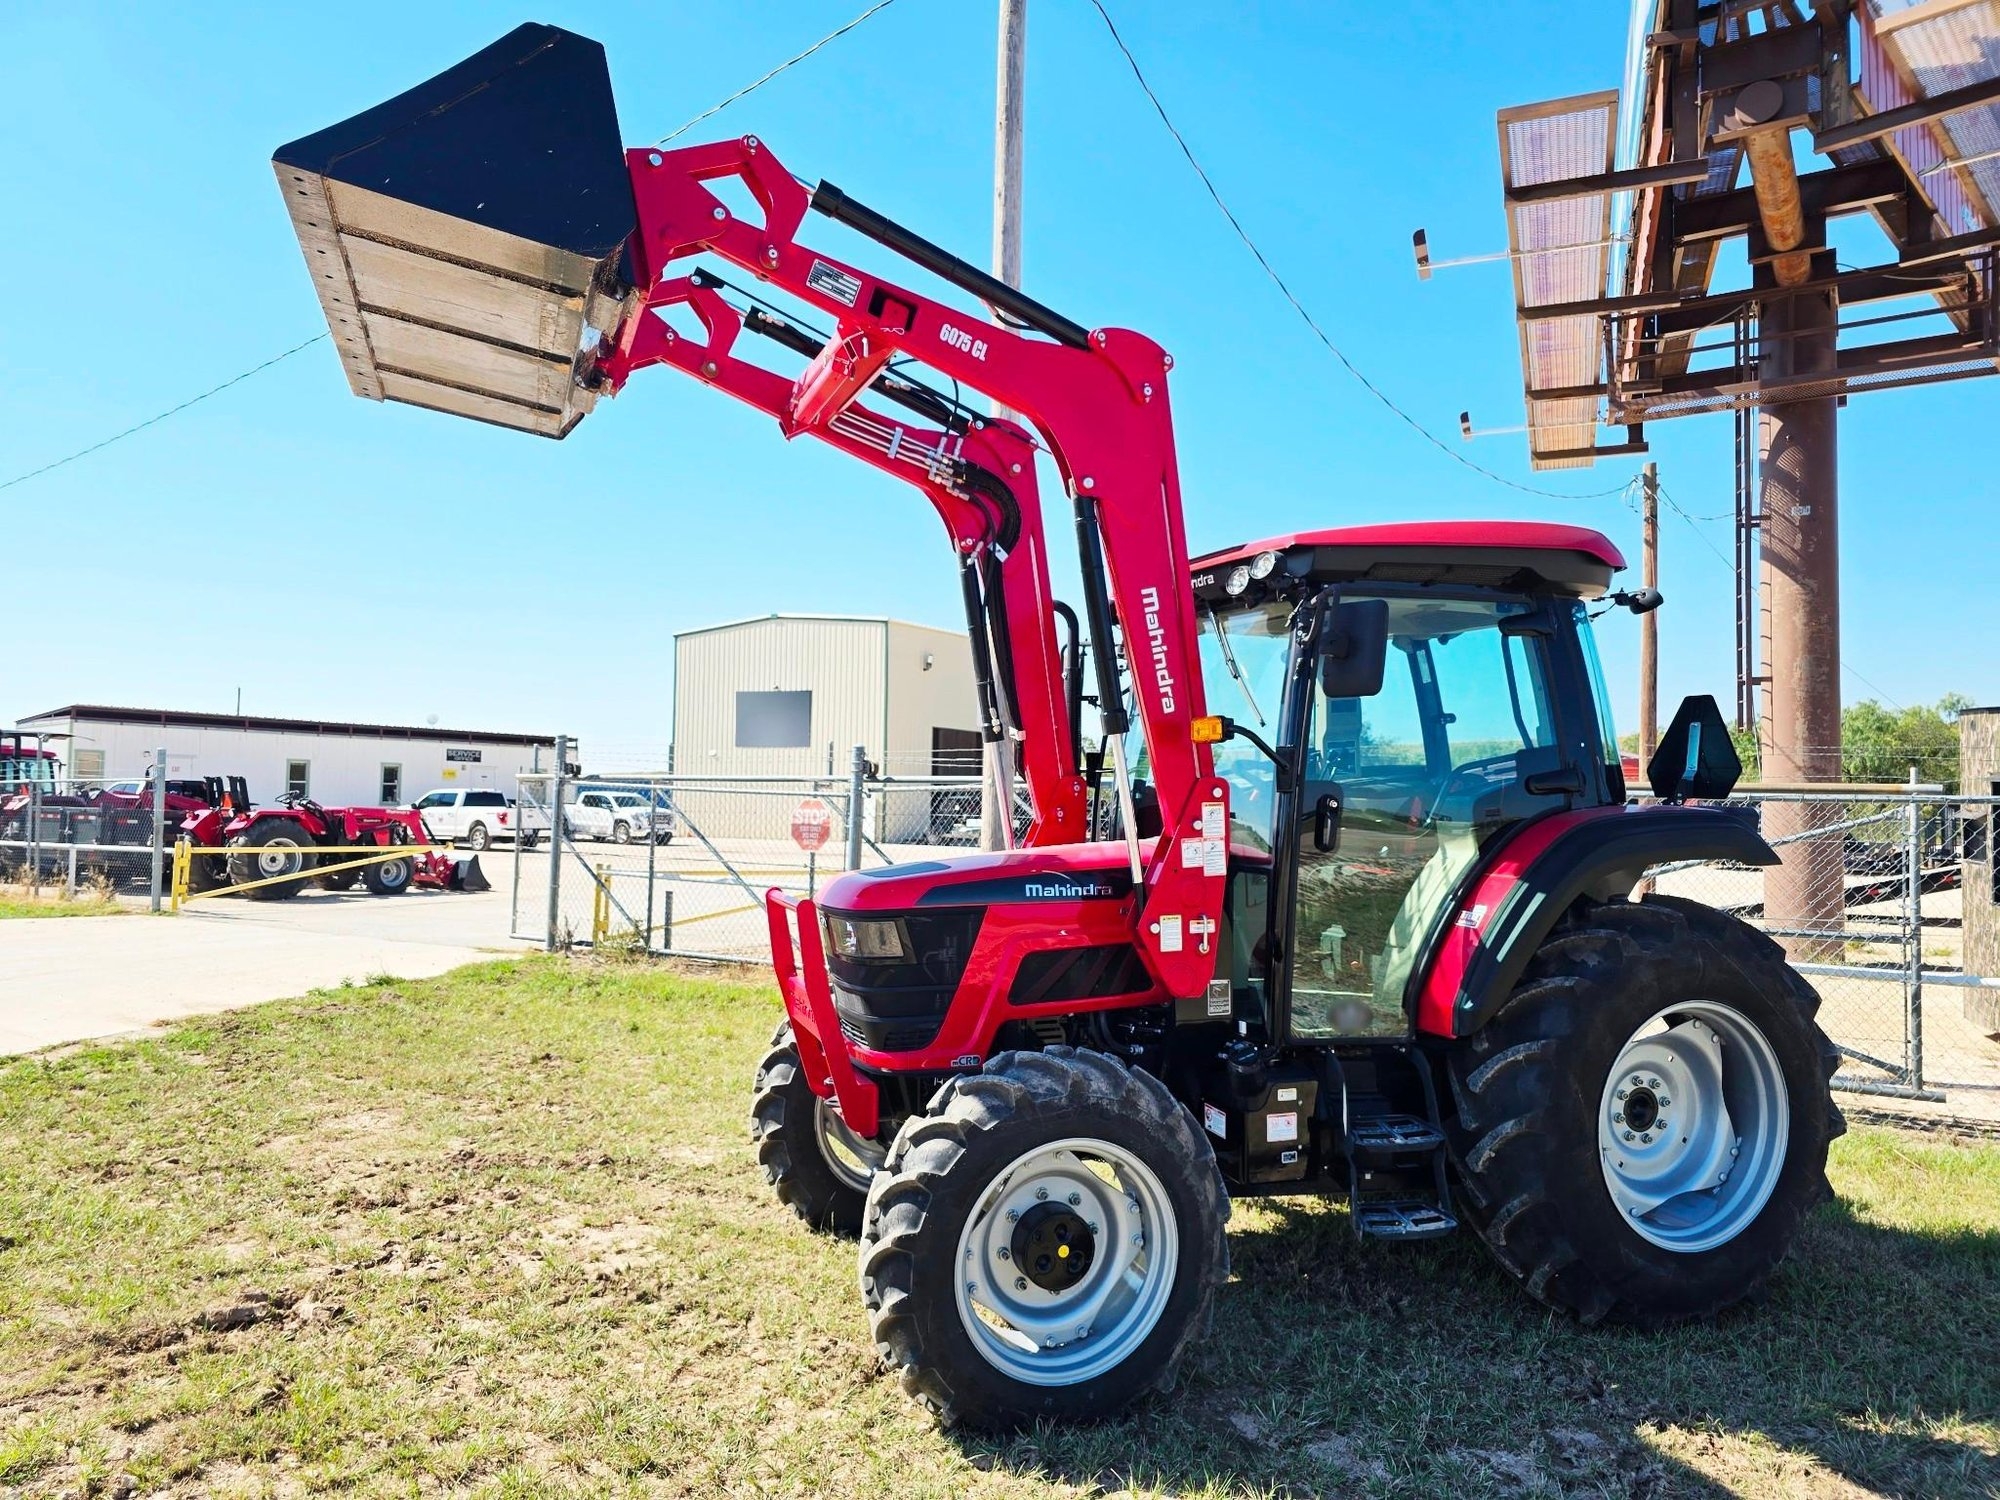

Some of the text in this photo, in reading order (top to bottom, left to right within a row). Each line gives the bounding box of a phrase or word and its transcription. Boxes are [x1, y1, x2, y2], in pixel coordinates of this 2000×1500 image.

[940, 323, 988, 362] 6075 CL
[1141, 587, 1175, 714] Mahindra
[447, 750, 481, 758] SERVICE
[794, 809, 828, 824] STOP
[1025, 884, 1113, 897] Mahindra
